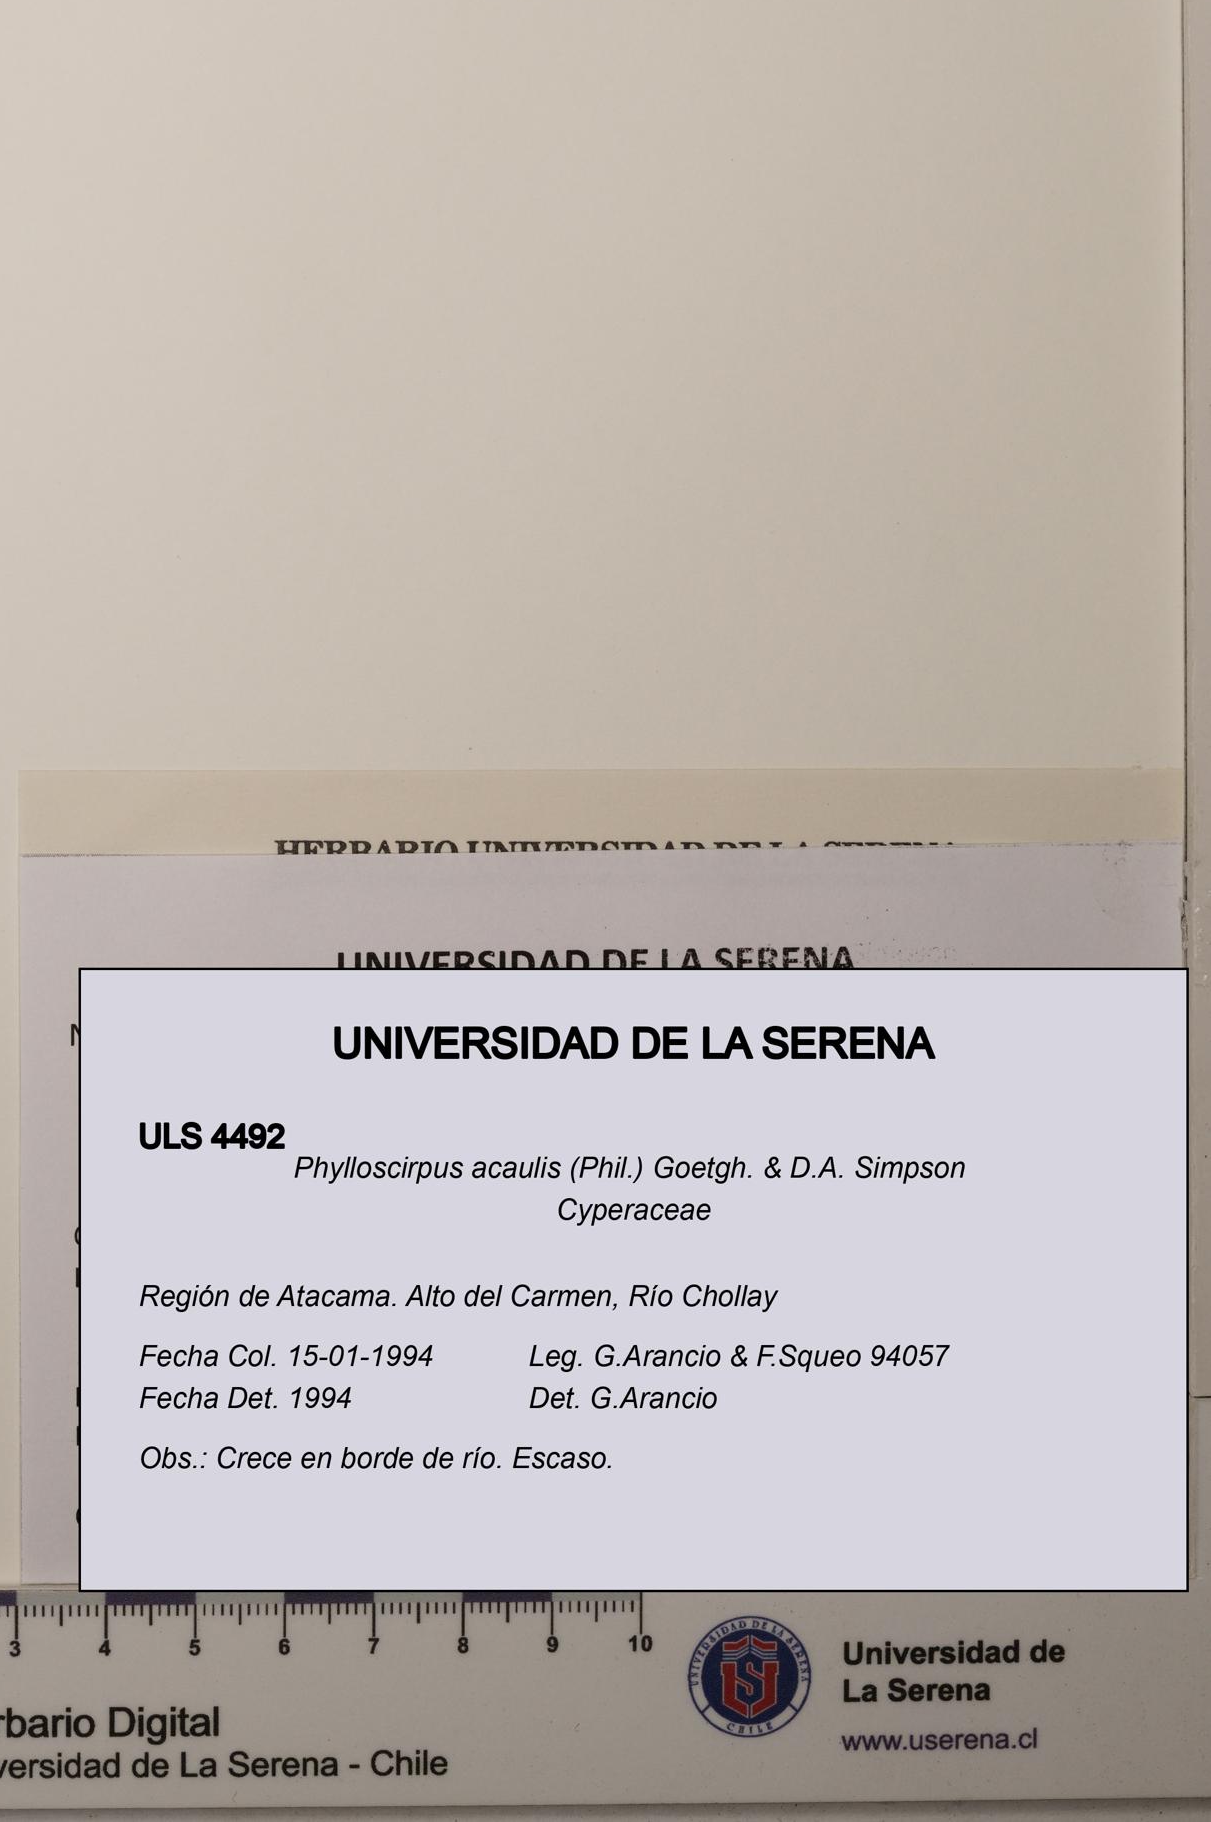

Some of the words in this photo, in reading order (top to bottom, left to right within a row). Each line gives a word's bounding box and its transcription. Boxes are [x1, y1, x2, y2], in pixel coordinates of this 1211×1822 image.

[9, 1641, 22, 1658] 3
[98, 1639, 112, 1657] 4
[188, 1639, 202, 1657] 5
[278, 1638, 291, 1656] 6
[367, 1638, 380, 1655] 7
[457, 1637, 469, 1654] 8
[546, 1636, 559, 1653] 9
[628, 1634, 654, 1653] 10
[691, 1620, 747, 1686] UNIVERSIDAD
[751, 1620, 768, 1630] DE
[772, 1624, 784, 1638] LA
[785, 1637, 809, 1682] SERENA
[843, 1639, 1020, 1666] Universidad
[1029, 1638, 1066, 1664] de
[843, 1679, 878, 1703] La
[887, 1677, 991, 1703] Serena
[108, 1705, 220, 1745] Digital
[726, 1721, 774, 1735] CHILE
[841, 1727, 1038, 1752] www.userena.cl
[131, 1751, 170, 1779] de
[180, 1751, 217, 1779] La
[228, 1750, 339, 1778] Serena
[370, 1749, 449, 1777] Chile
